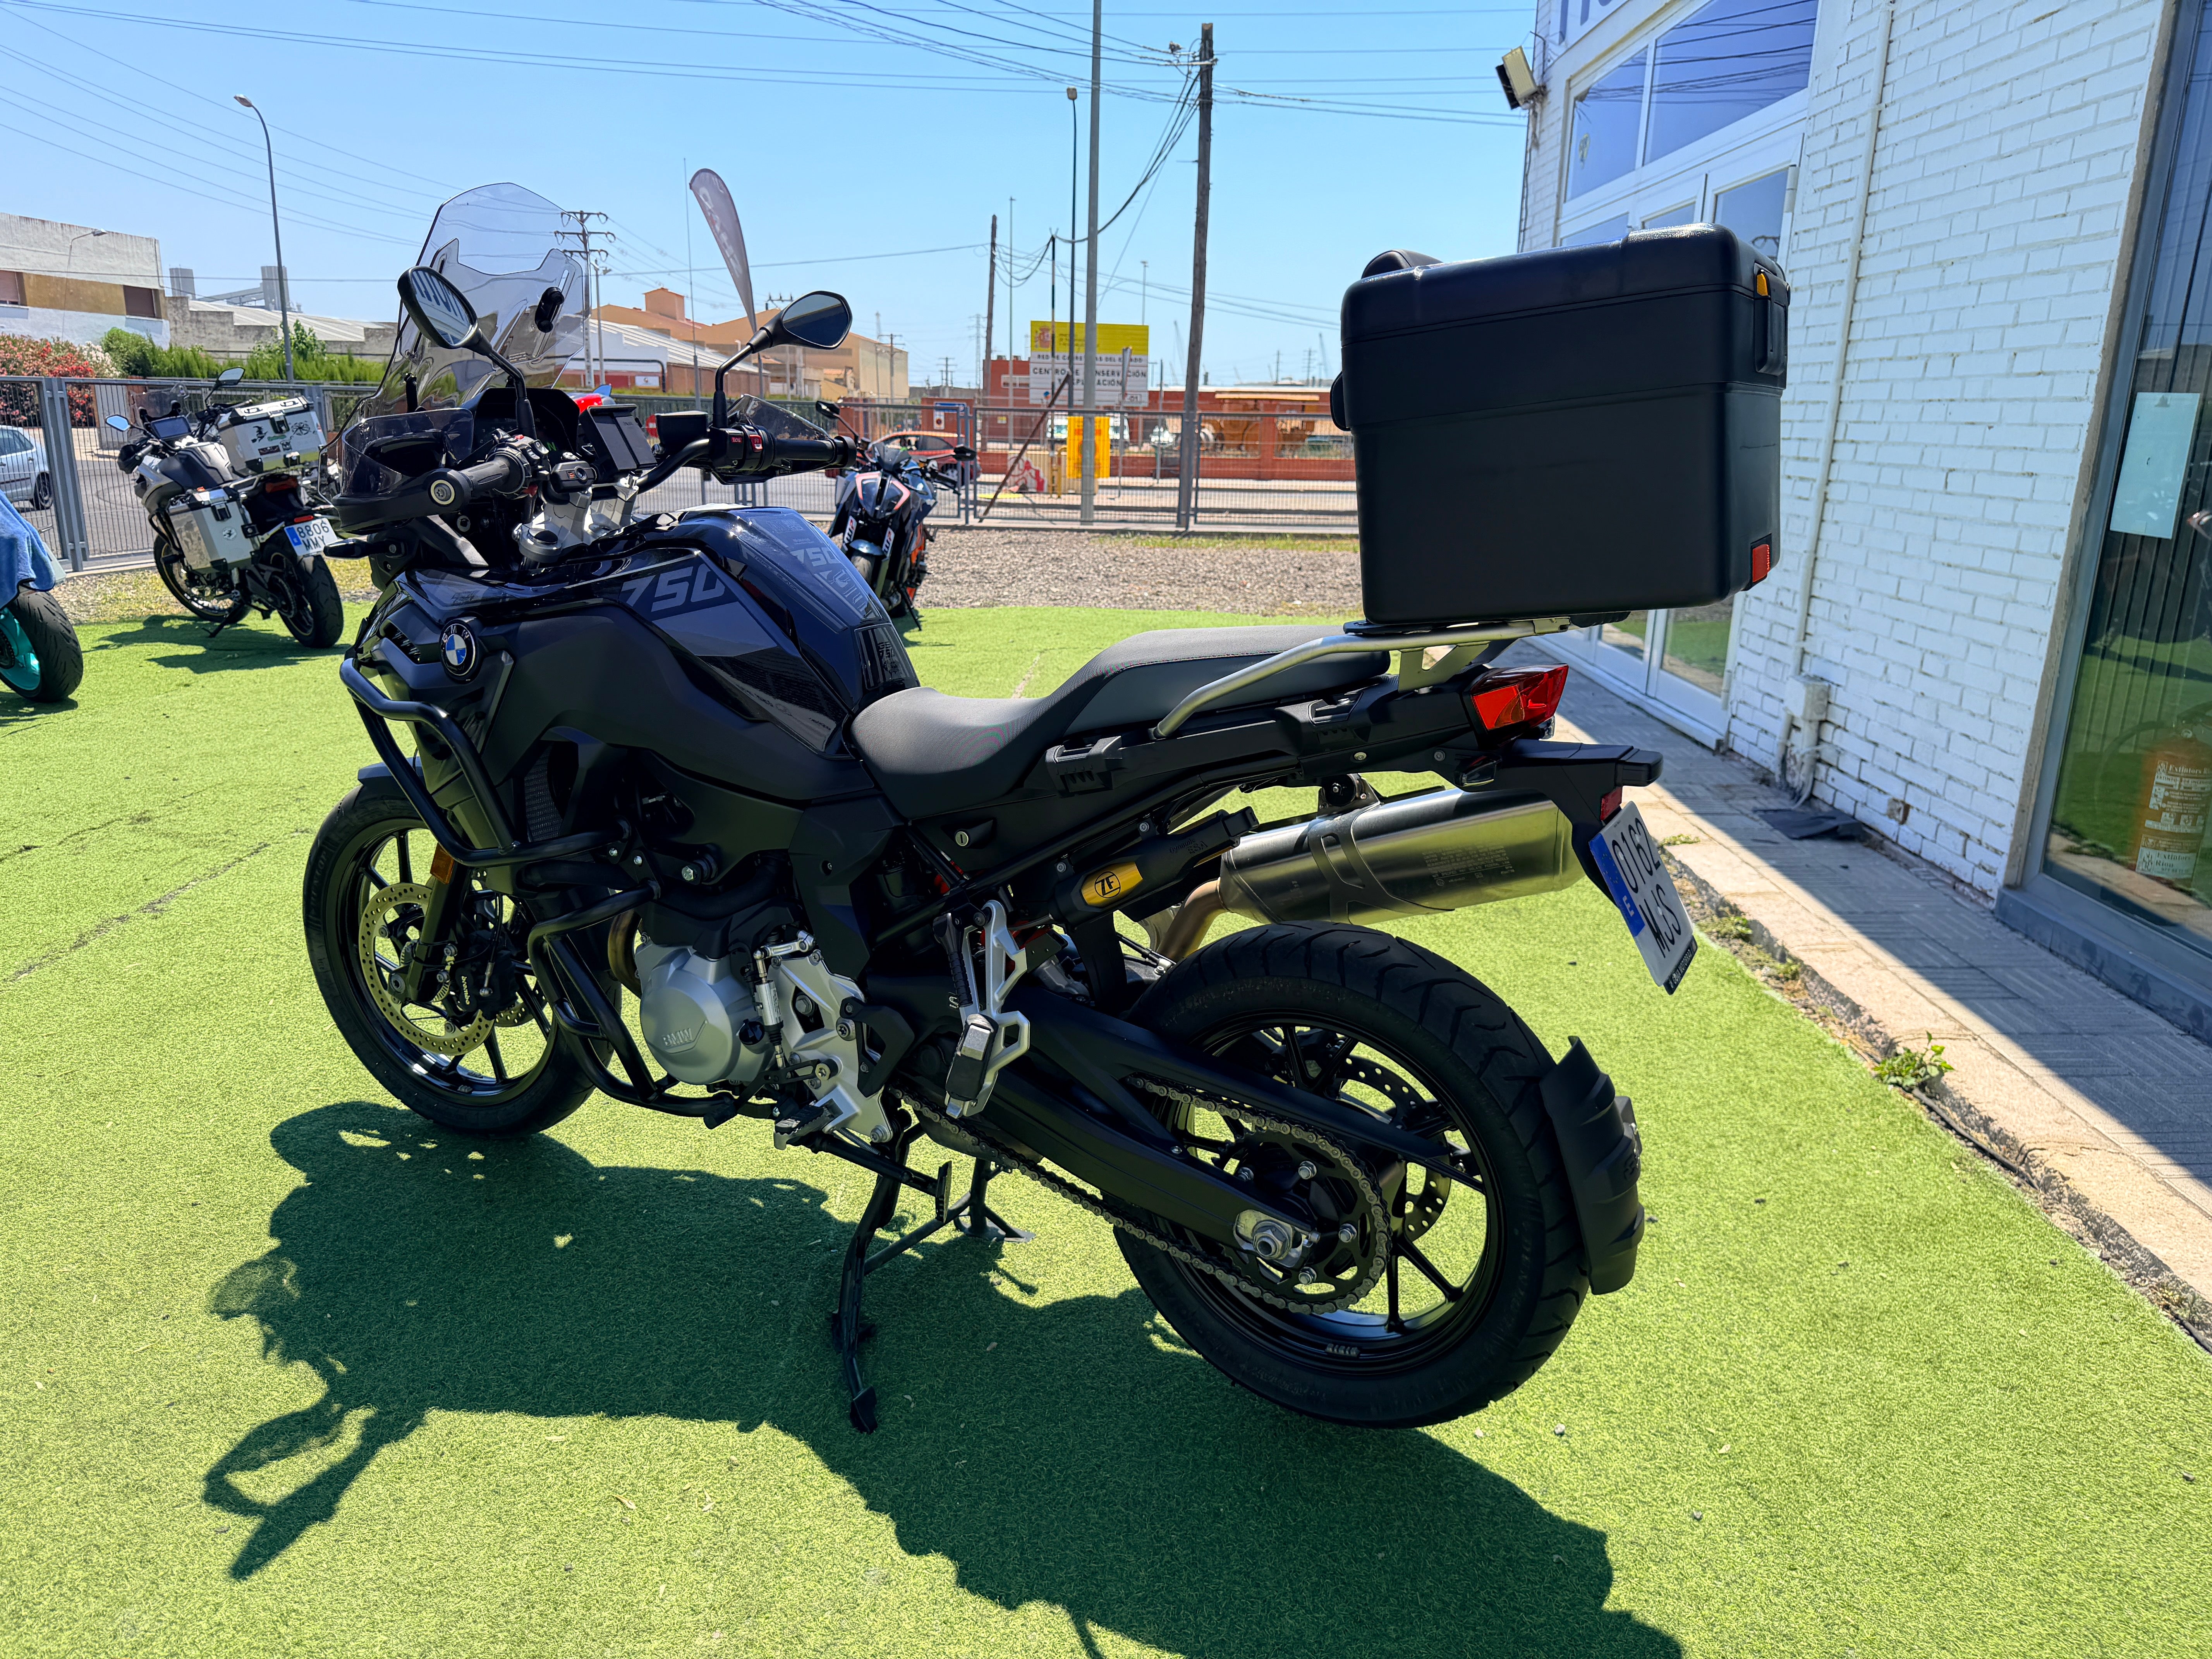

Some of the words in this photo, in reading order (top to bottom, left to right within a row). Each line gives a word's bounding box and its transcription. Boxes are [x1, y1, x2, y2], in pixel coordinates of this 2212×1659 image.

[1085, 369, 1147, 378] NSERVCIÓN
[297, 520, 329, 538] 8806
[302, 535, 326, 551] MMY
[621, 563, 725, 612] 750
[442, 625, 470, 643] BMW
[1612, 817, 1661, 894] 0162
[1096, 873, 1120, 896] ZF
[1623, 895, 1635, 917] E
[1639, 883, 1681, 958] MJS
[461, 975, 471, 1005] brembo
[663, 1027, 693, 1047] BMW
